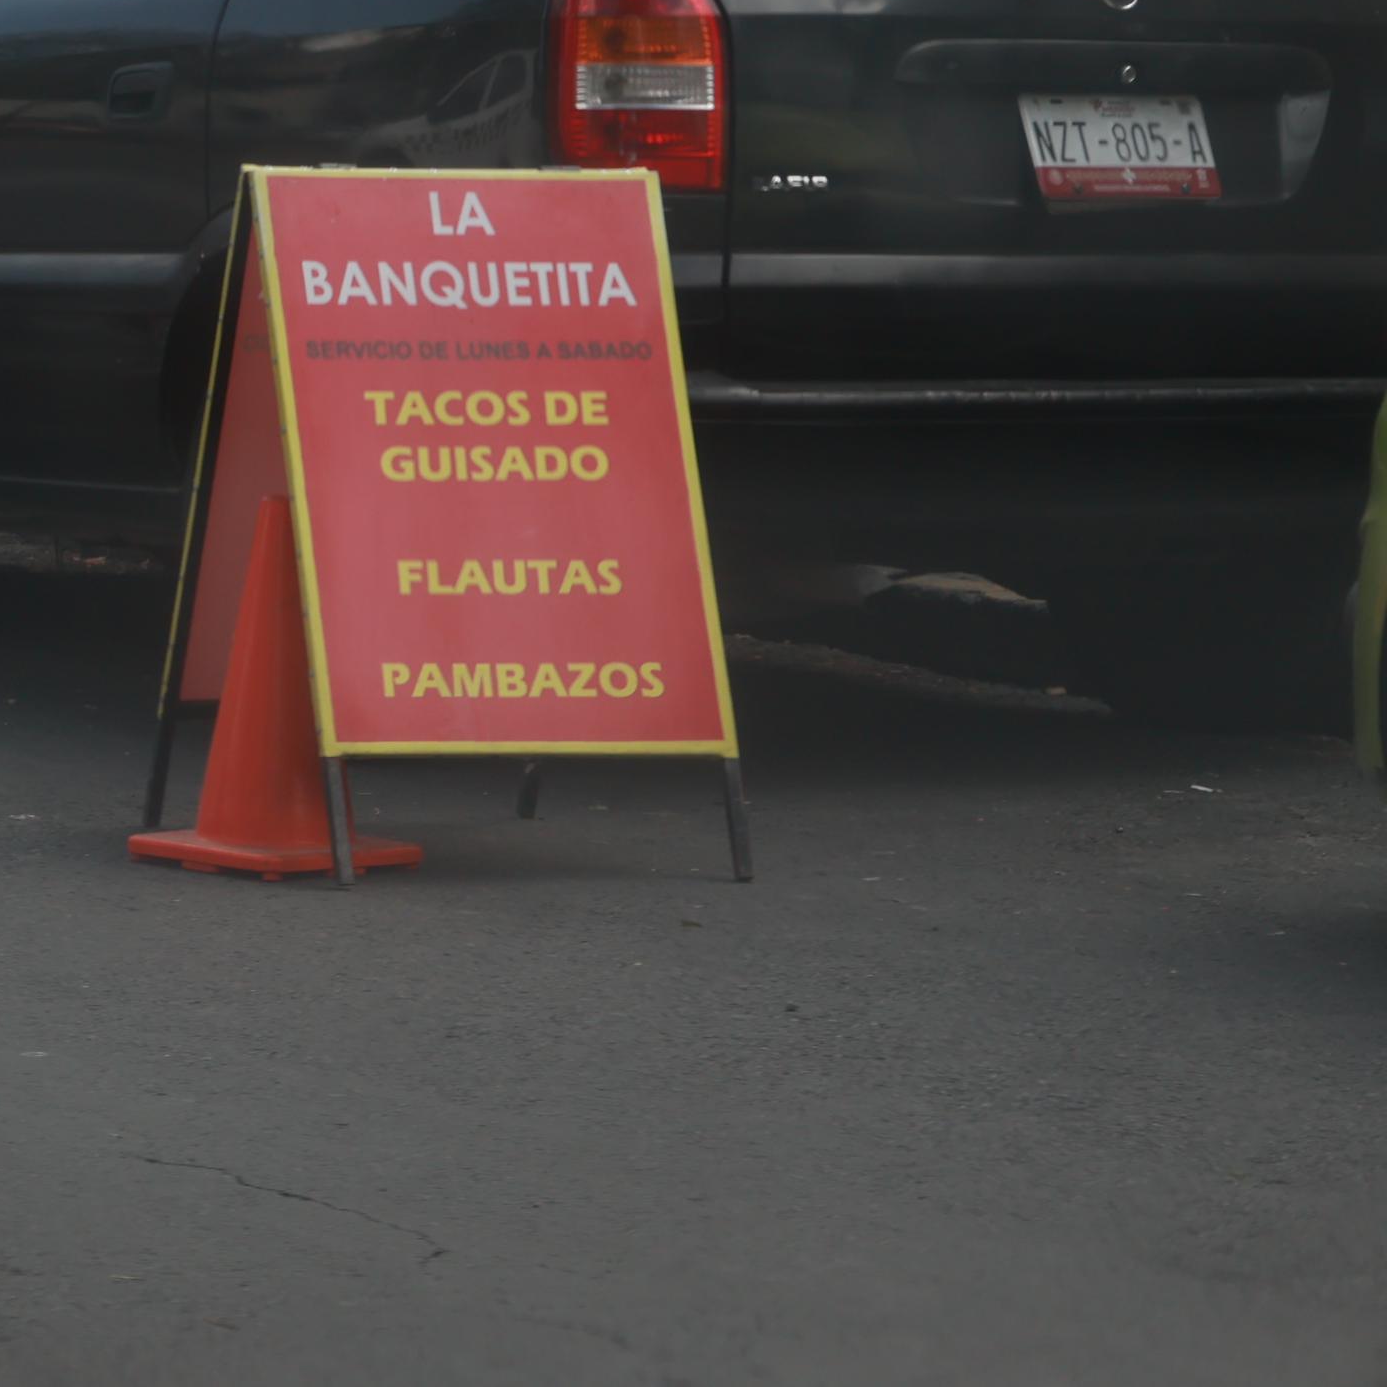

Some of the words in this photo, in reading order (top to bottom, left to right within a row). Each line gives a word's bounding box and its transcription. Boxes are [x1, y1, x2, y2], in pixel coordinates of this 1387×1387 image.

[1033, 121, 1208, 164] NZT-805-A
[430, 190, 496, 236] LA
[301, 259, 638, 309] BANQUETITA
[305, 338, 414, 362] SERVICIO
[418, 339, 451, 362] DE
[455, 339, 531, 362] LUNES
[534, 339, 554, 361] A
[556, 339, 653, 362] SABADO
[363, 390, 531, 427] TACOS
[545, 390, 610, 427] DE
[379, 444, 611, 482] GUISADO
[396, 558, 624, 596] FLAUTAS
[381, 661, 667, 700] PAMBAZOS
